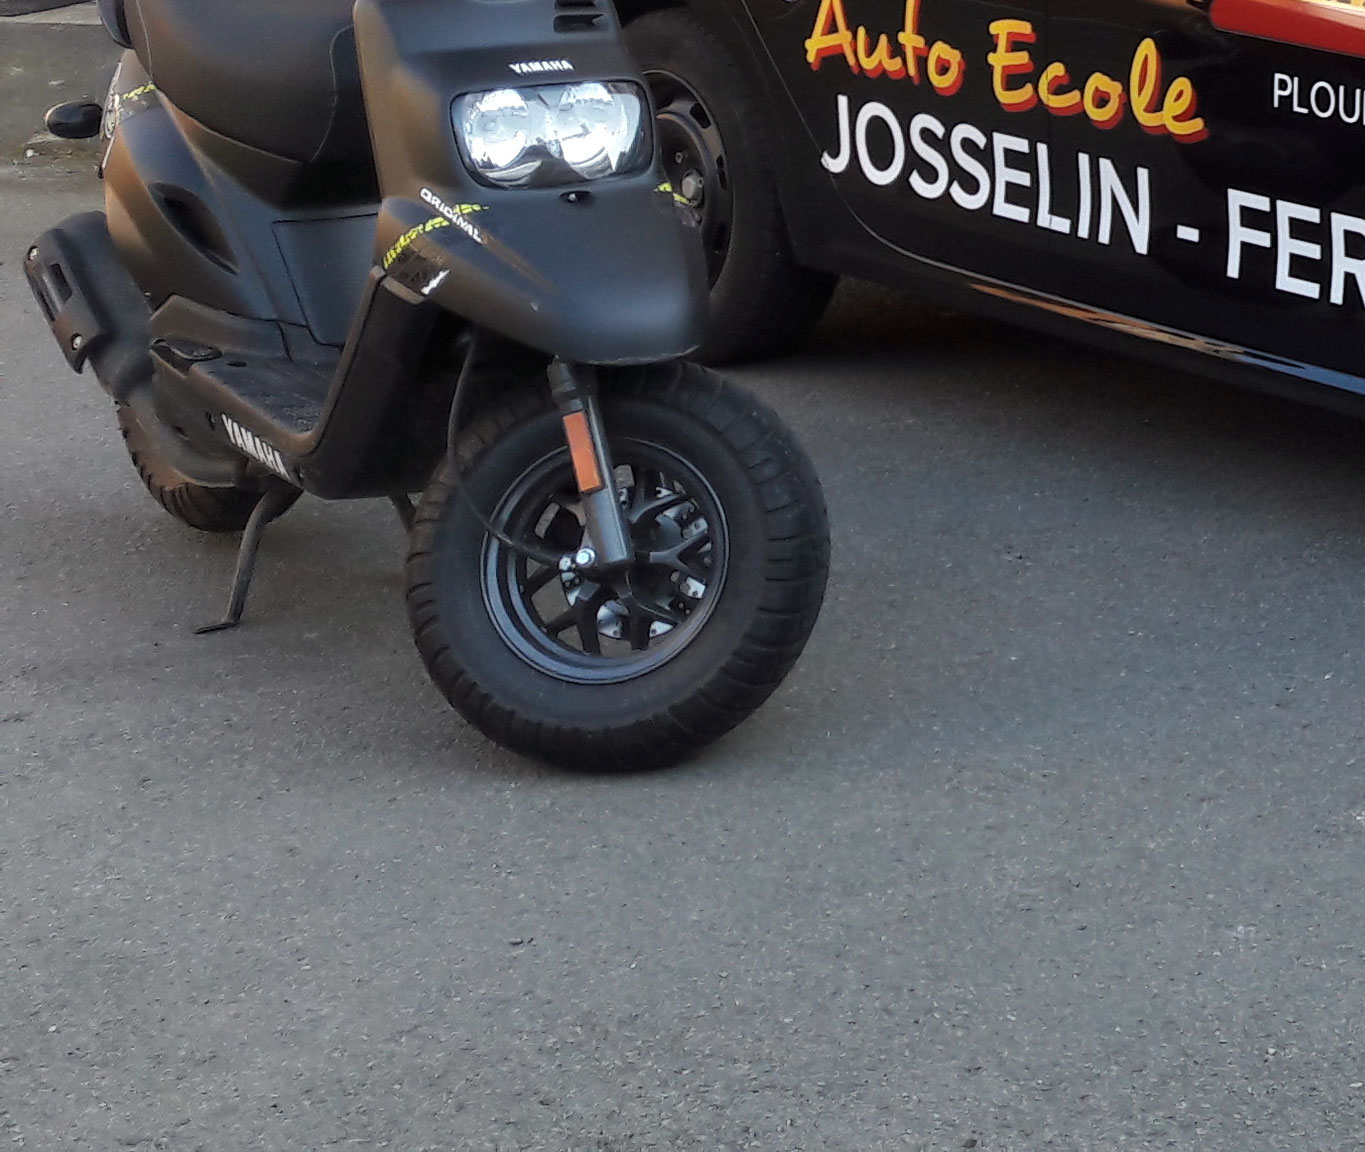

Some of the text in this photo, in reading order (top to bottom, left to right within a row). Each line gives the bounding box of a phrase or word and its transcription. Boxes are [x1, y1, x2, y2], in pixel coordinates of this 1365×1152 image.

[508, 59, 574, 74] YAMAHA
[988, 18, 1209, 143] Ecole
[820, 94, 1150, 255] JOSSELIN
[221, 413, 291, 482] YAMAHA
